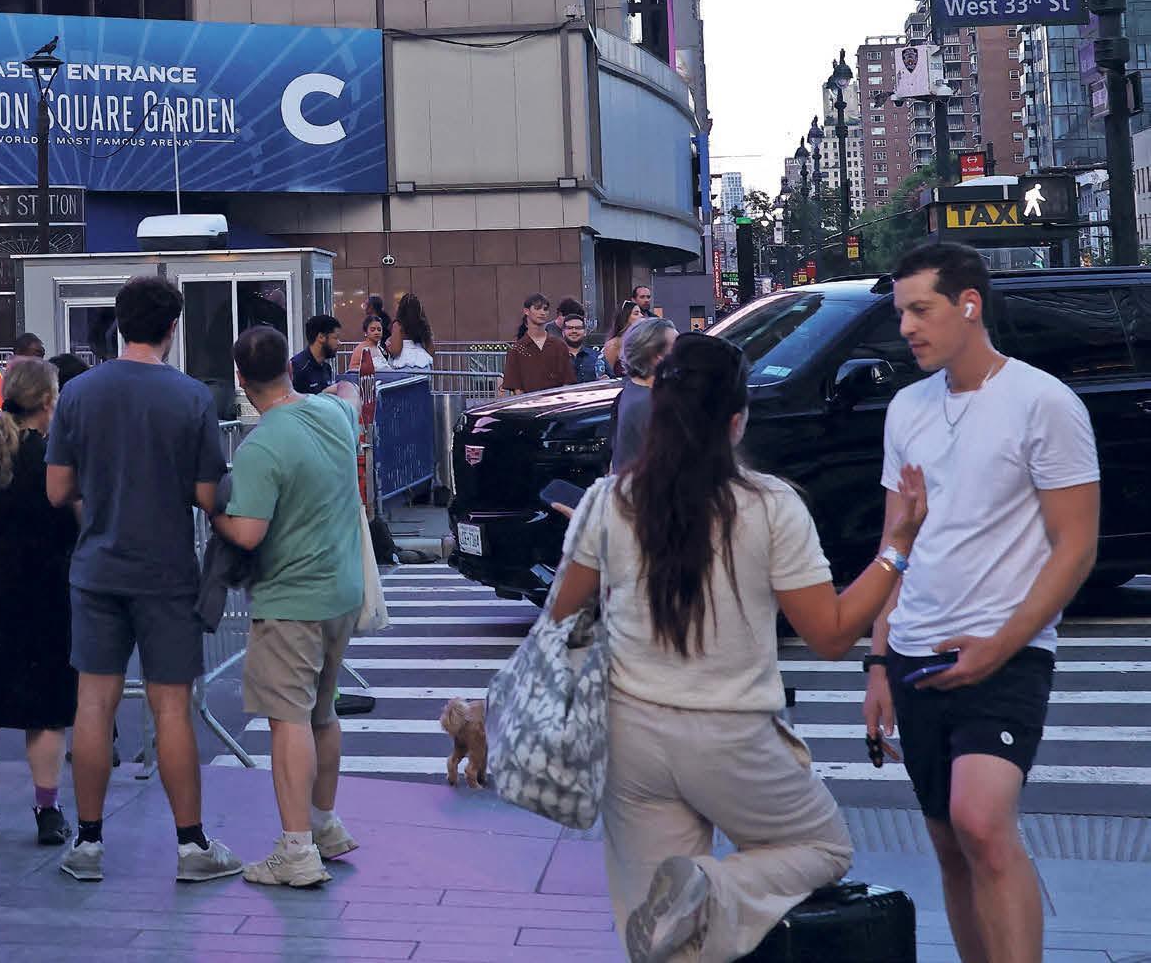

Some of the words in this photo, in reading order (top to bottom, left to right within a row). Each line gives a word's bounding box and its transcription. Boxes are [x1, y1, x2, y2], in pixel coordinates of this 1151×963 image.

[67, 63, 197, 84] ENTRANCE
[280, 72, 347, 145] C
[56, 137, 90, 146] MOST
[96, 137, 146, 147] FAMOUS
[17, 194, 77, 216] STTION
[951, 203, 1018, 225] TAX
